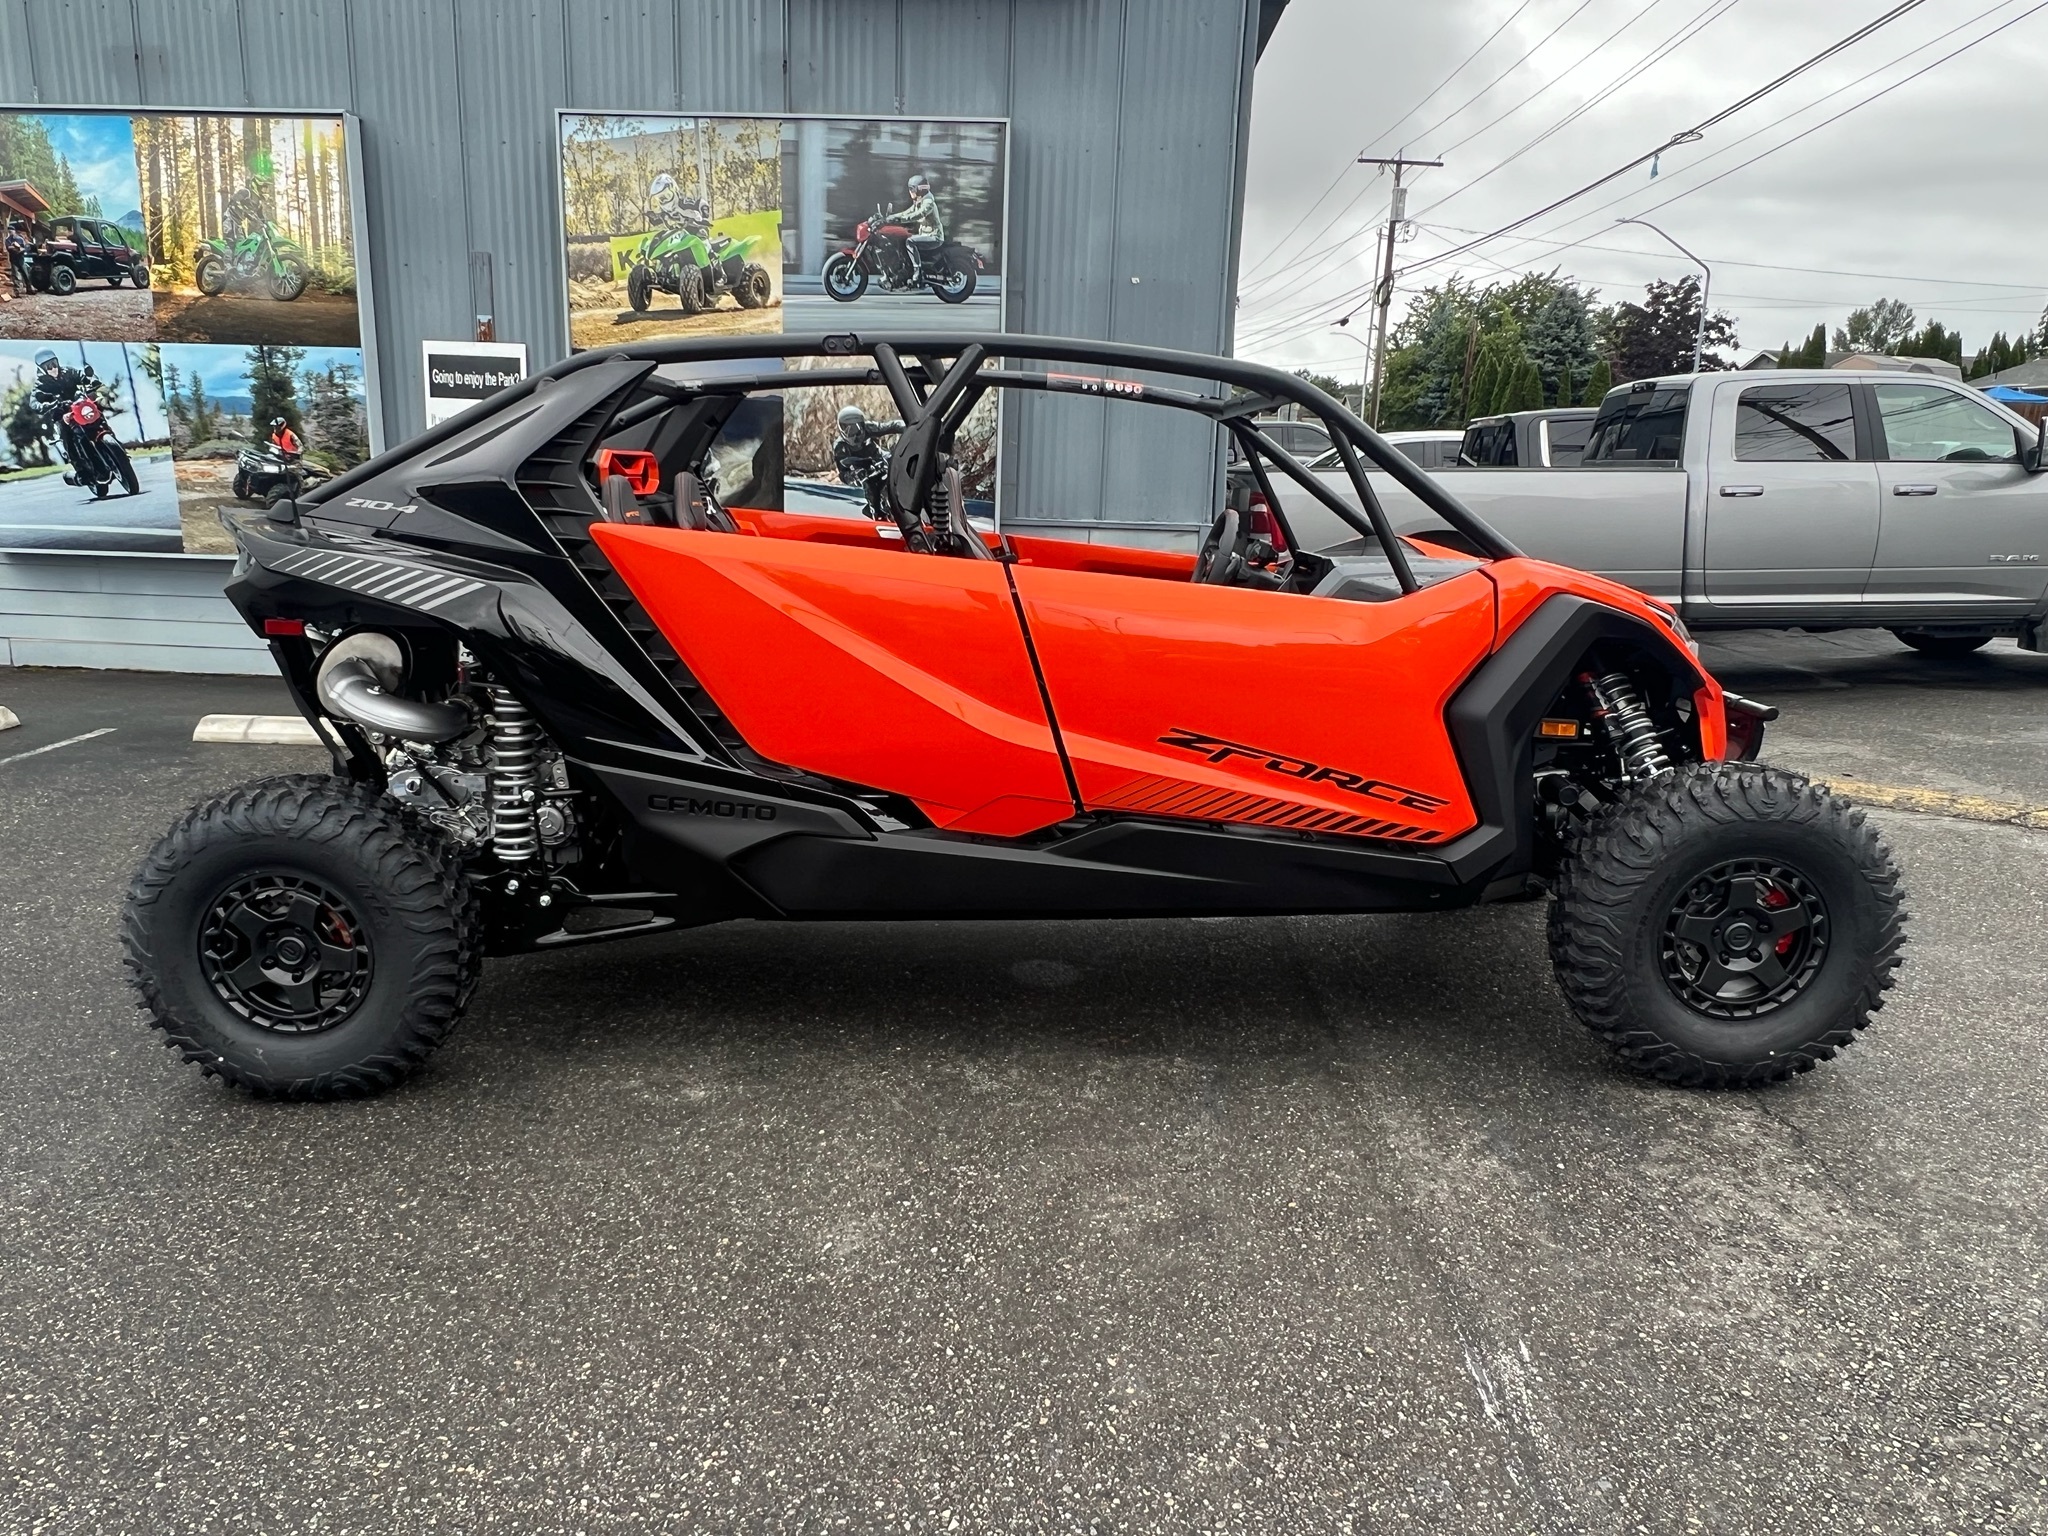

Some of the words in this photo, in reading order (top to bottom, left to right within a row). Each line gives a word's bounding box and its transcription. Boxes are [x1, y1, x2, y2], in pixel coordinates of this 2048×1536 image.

[432, 369, 455, 387] Going
[455, 371, 463, 384] to
[464, 371, 484, 389] enjoy
[485, 372, 497, 386] the
[498, 372, 519, 387] Park?
[1989, 554, 2040, 562] RAM
[1157, 727, 1450, 814] ZFORCE
[648, 794, 777, 821] CFMOTO
